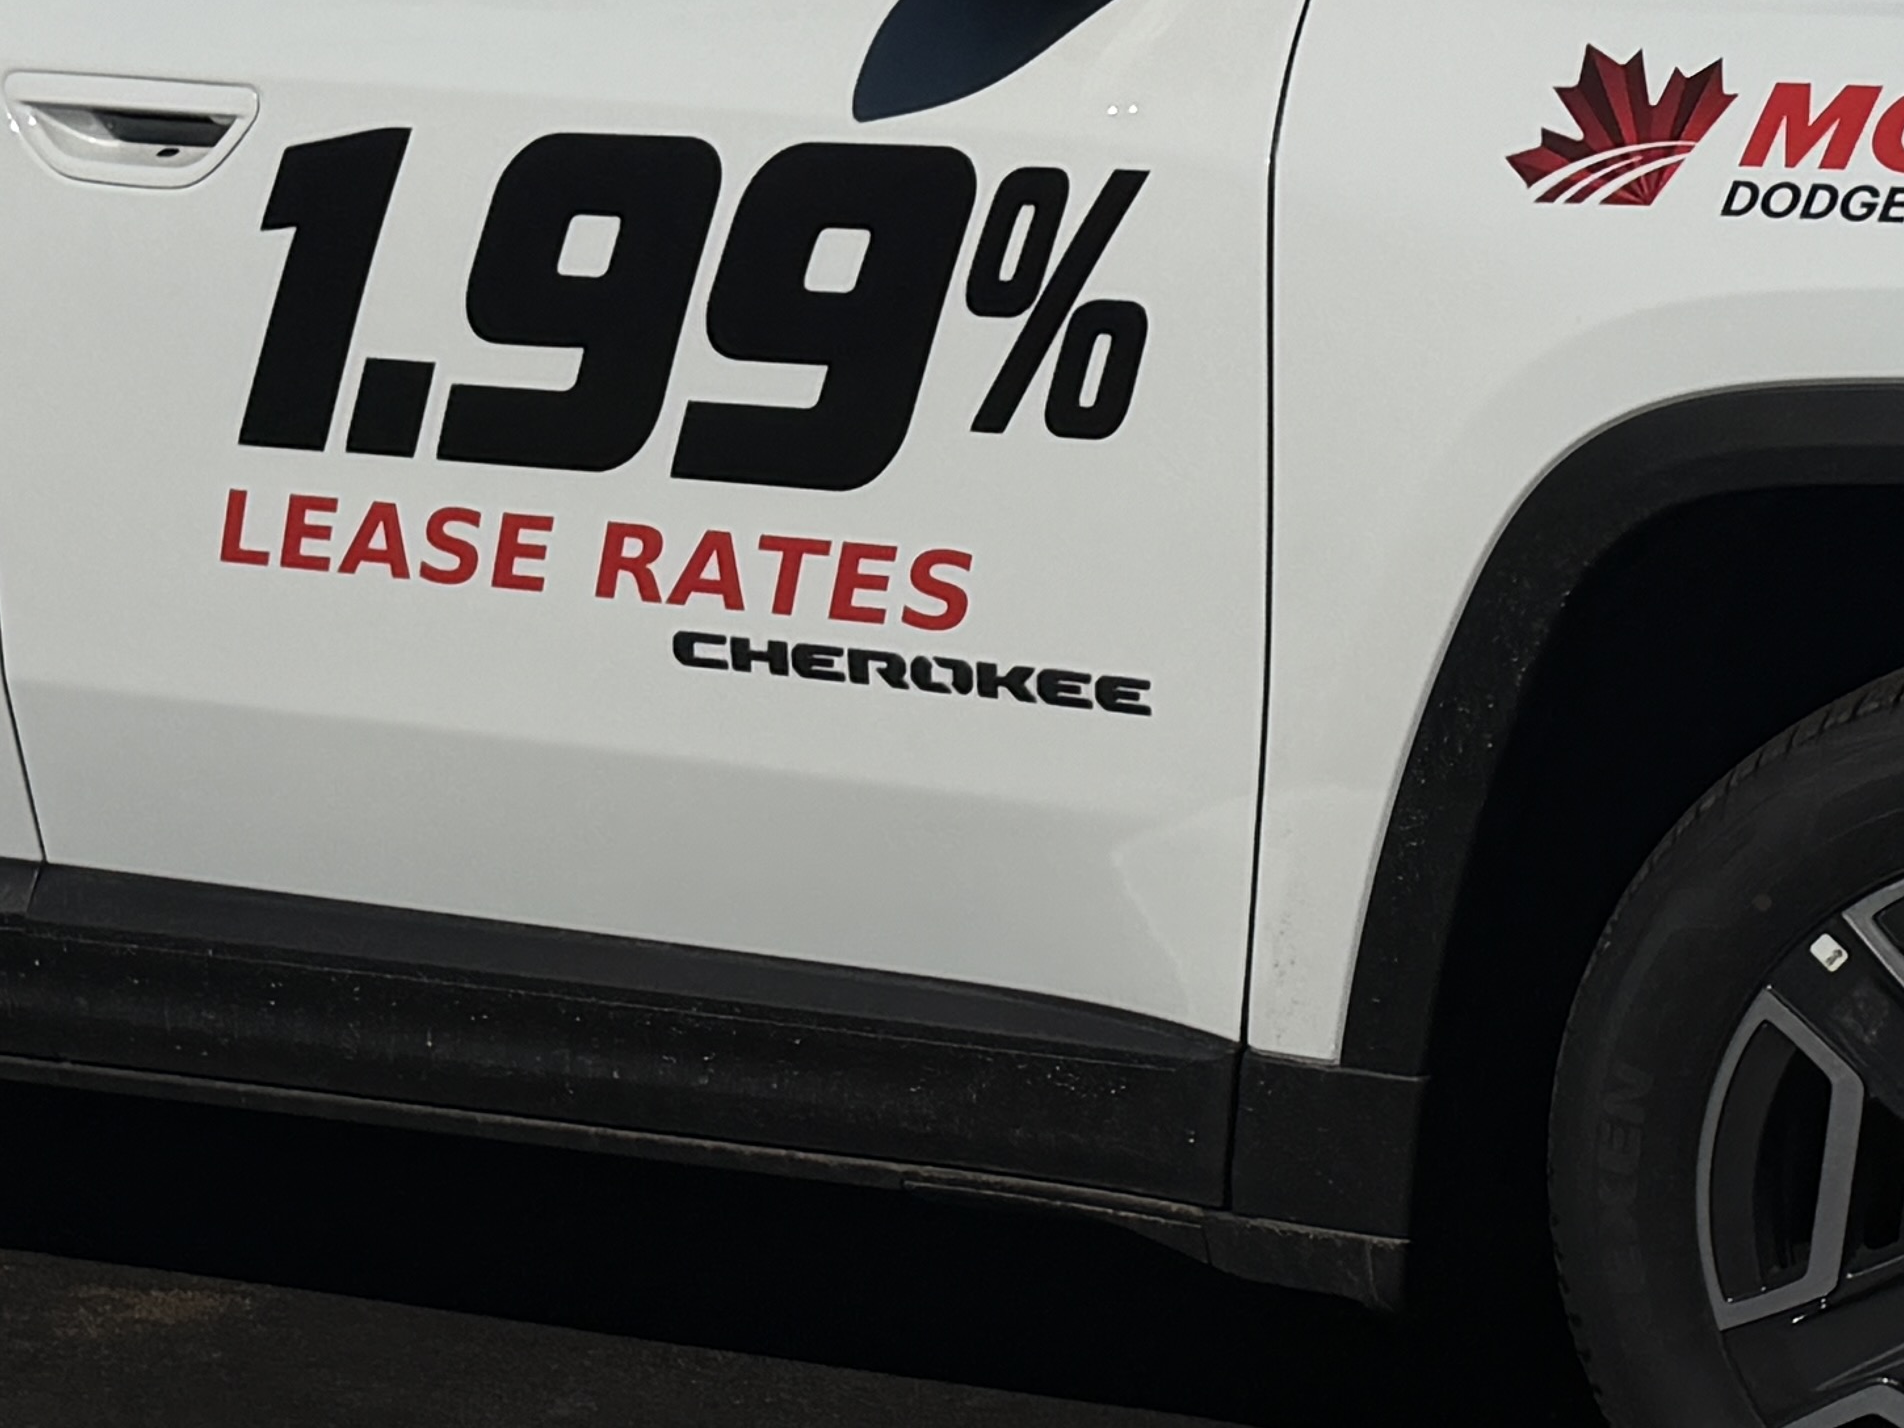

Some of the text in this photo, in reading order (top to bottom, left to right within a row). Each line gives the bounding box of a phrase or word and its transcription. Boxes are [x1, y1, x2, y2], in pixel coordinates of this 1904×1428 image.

[236, 126, 1151, 493] 1.99%
[221, 488, 974, 631] LEASE RATES
[671, 630, 1154, 718] CHEROKEE
